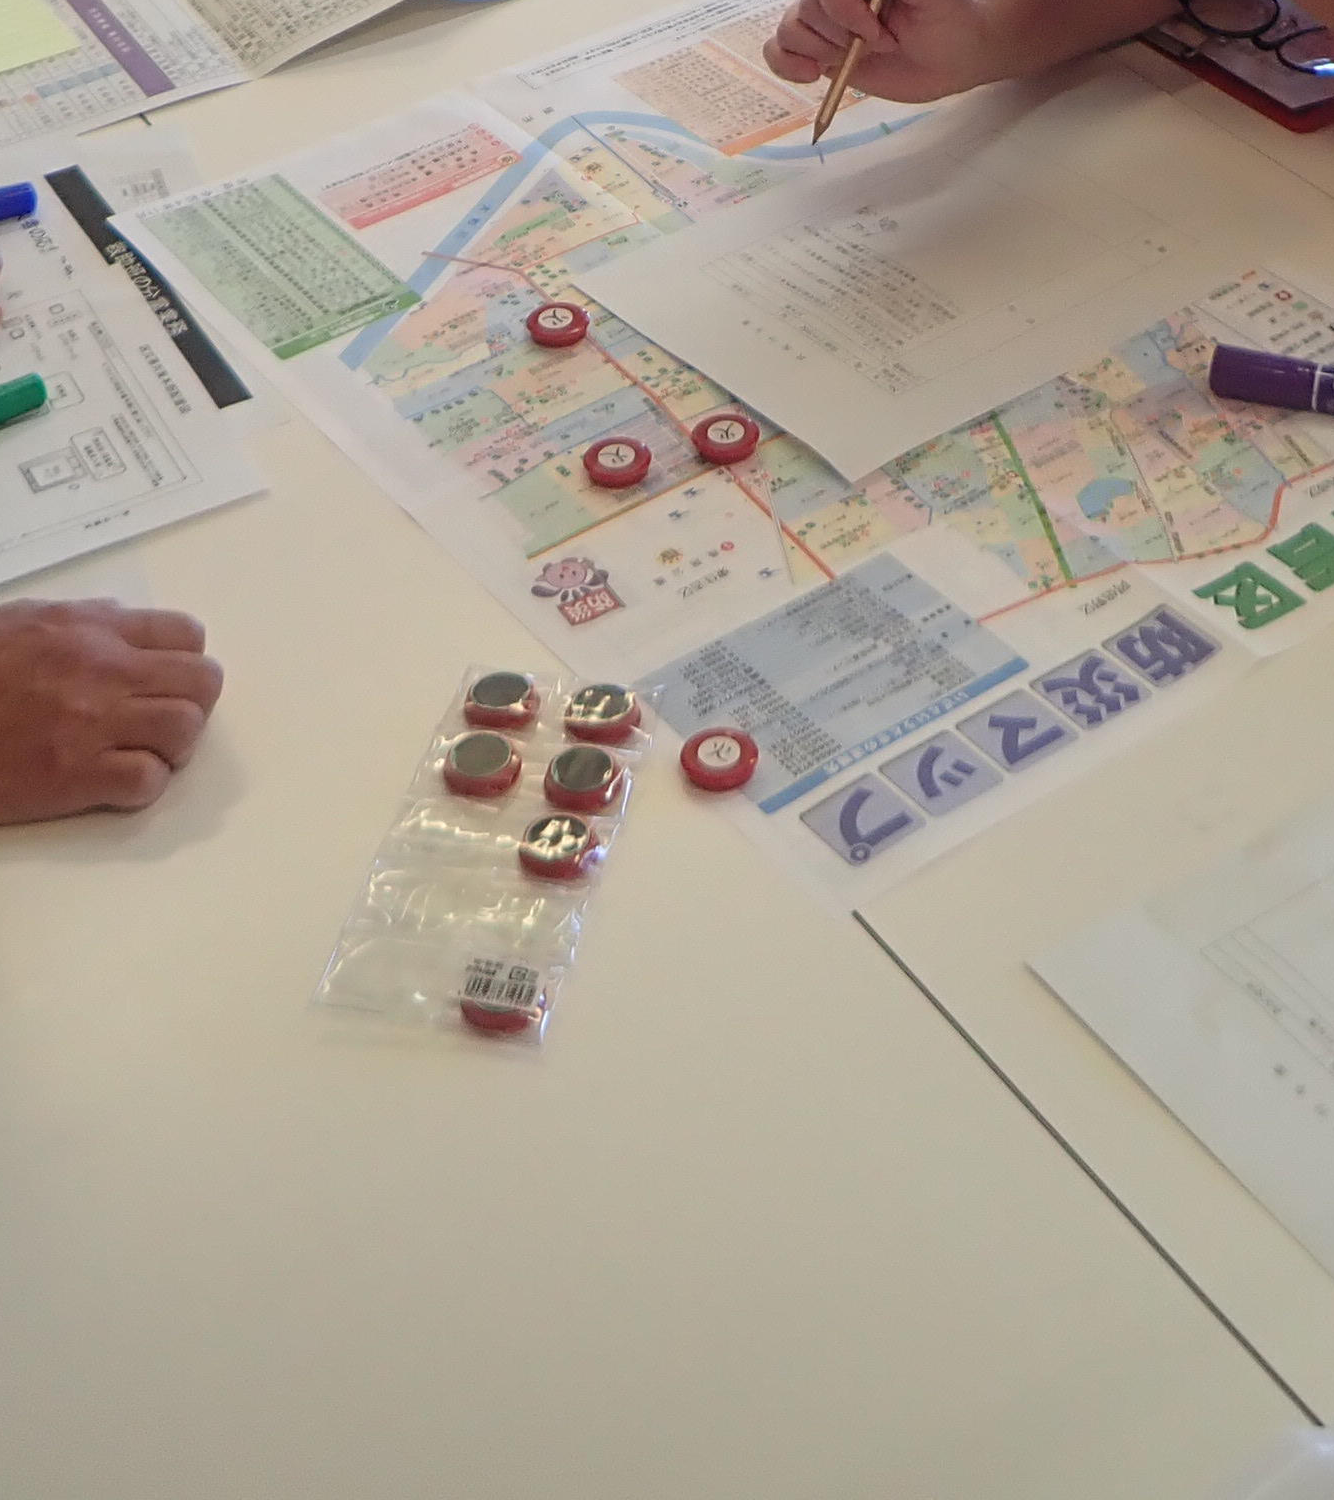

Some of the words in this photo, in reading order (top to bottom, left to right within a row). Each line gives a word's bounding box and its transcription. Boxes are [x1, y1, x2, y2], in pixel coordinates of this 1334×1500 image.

[837, 604, 1220, 866] 防災マップ
